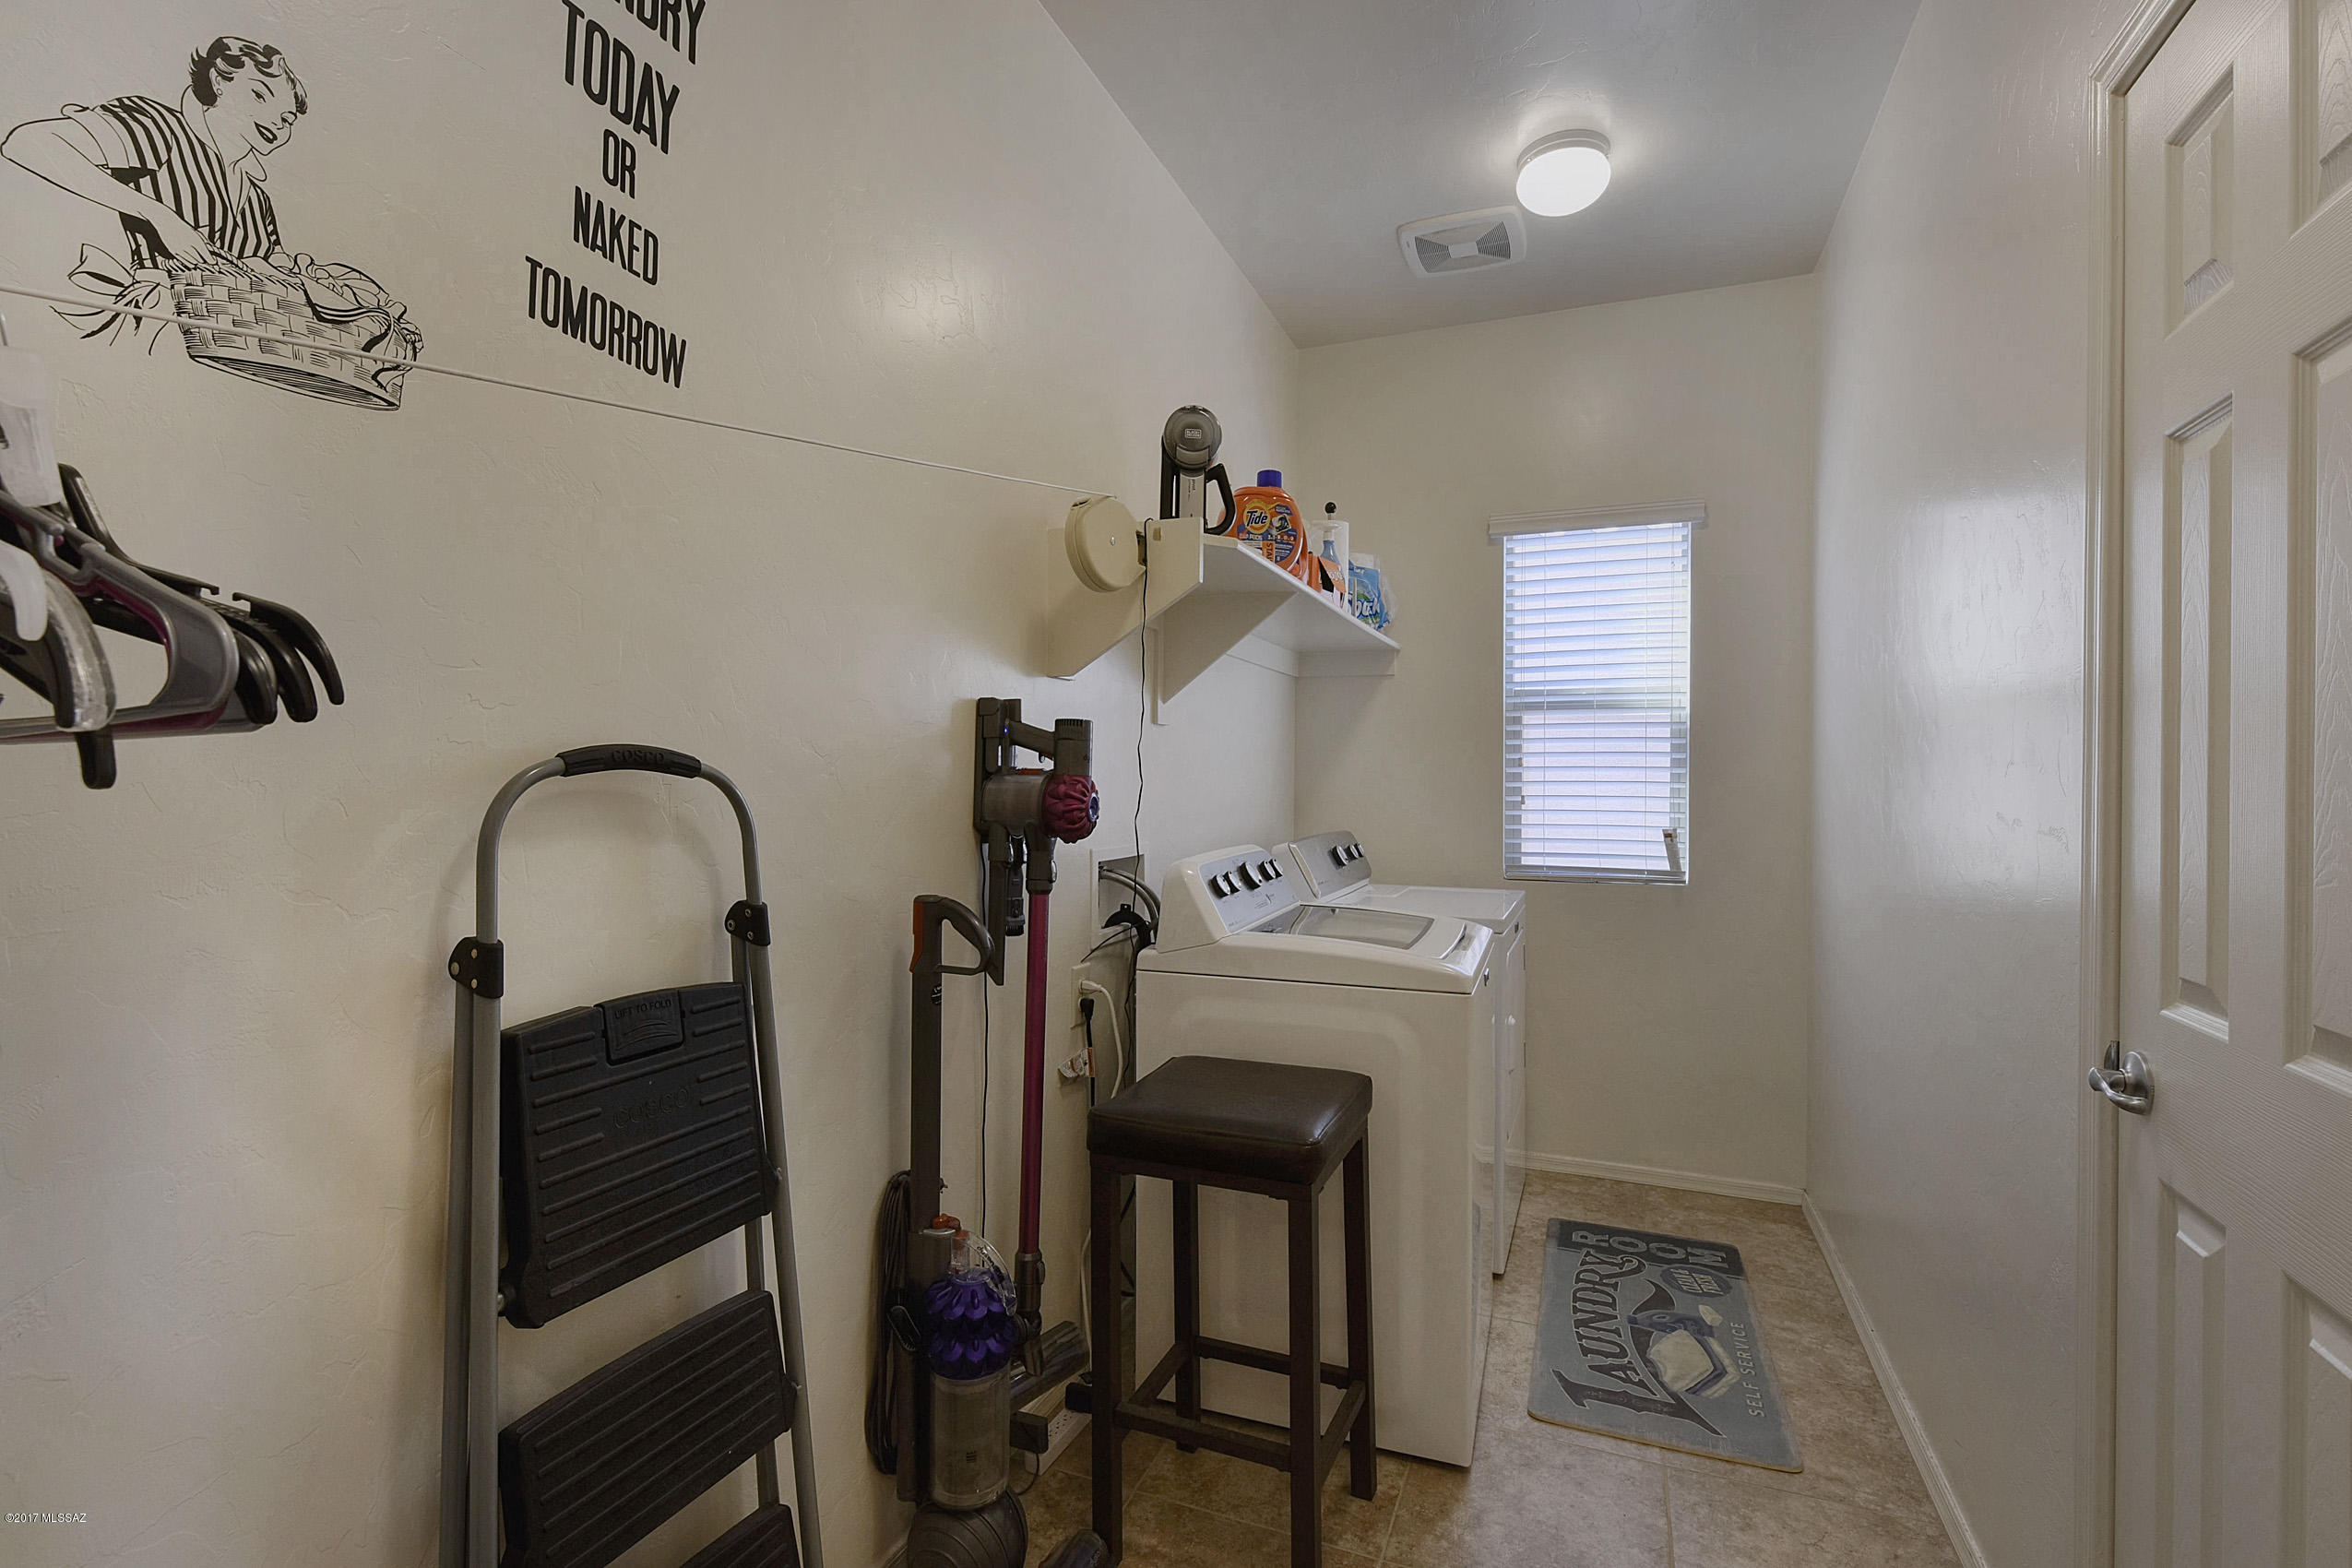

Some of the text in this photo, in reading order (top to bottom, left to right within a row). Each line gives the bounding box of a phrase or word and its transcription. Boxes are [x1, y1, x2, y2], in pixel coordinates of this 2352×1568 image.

[562, 0, 680, 155] TODAY
[602, 128, 636, 199] OR
[573, 185, 659, 286] NAKED
[525, 255, 686, 388] TOMORROW
[1246, 510, 1268, 528] Tide
[612, 749, 664, 764] COSCO
[614, 998, 672, 1020] LIFT TO FOLD
[1572, 1229, 1729, 1269] ROOM
[1550, 1247, 1728, 1438] LAUNDRY
[1730, 1321, 1765, 1418] SELF SERVICE
